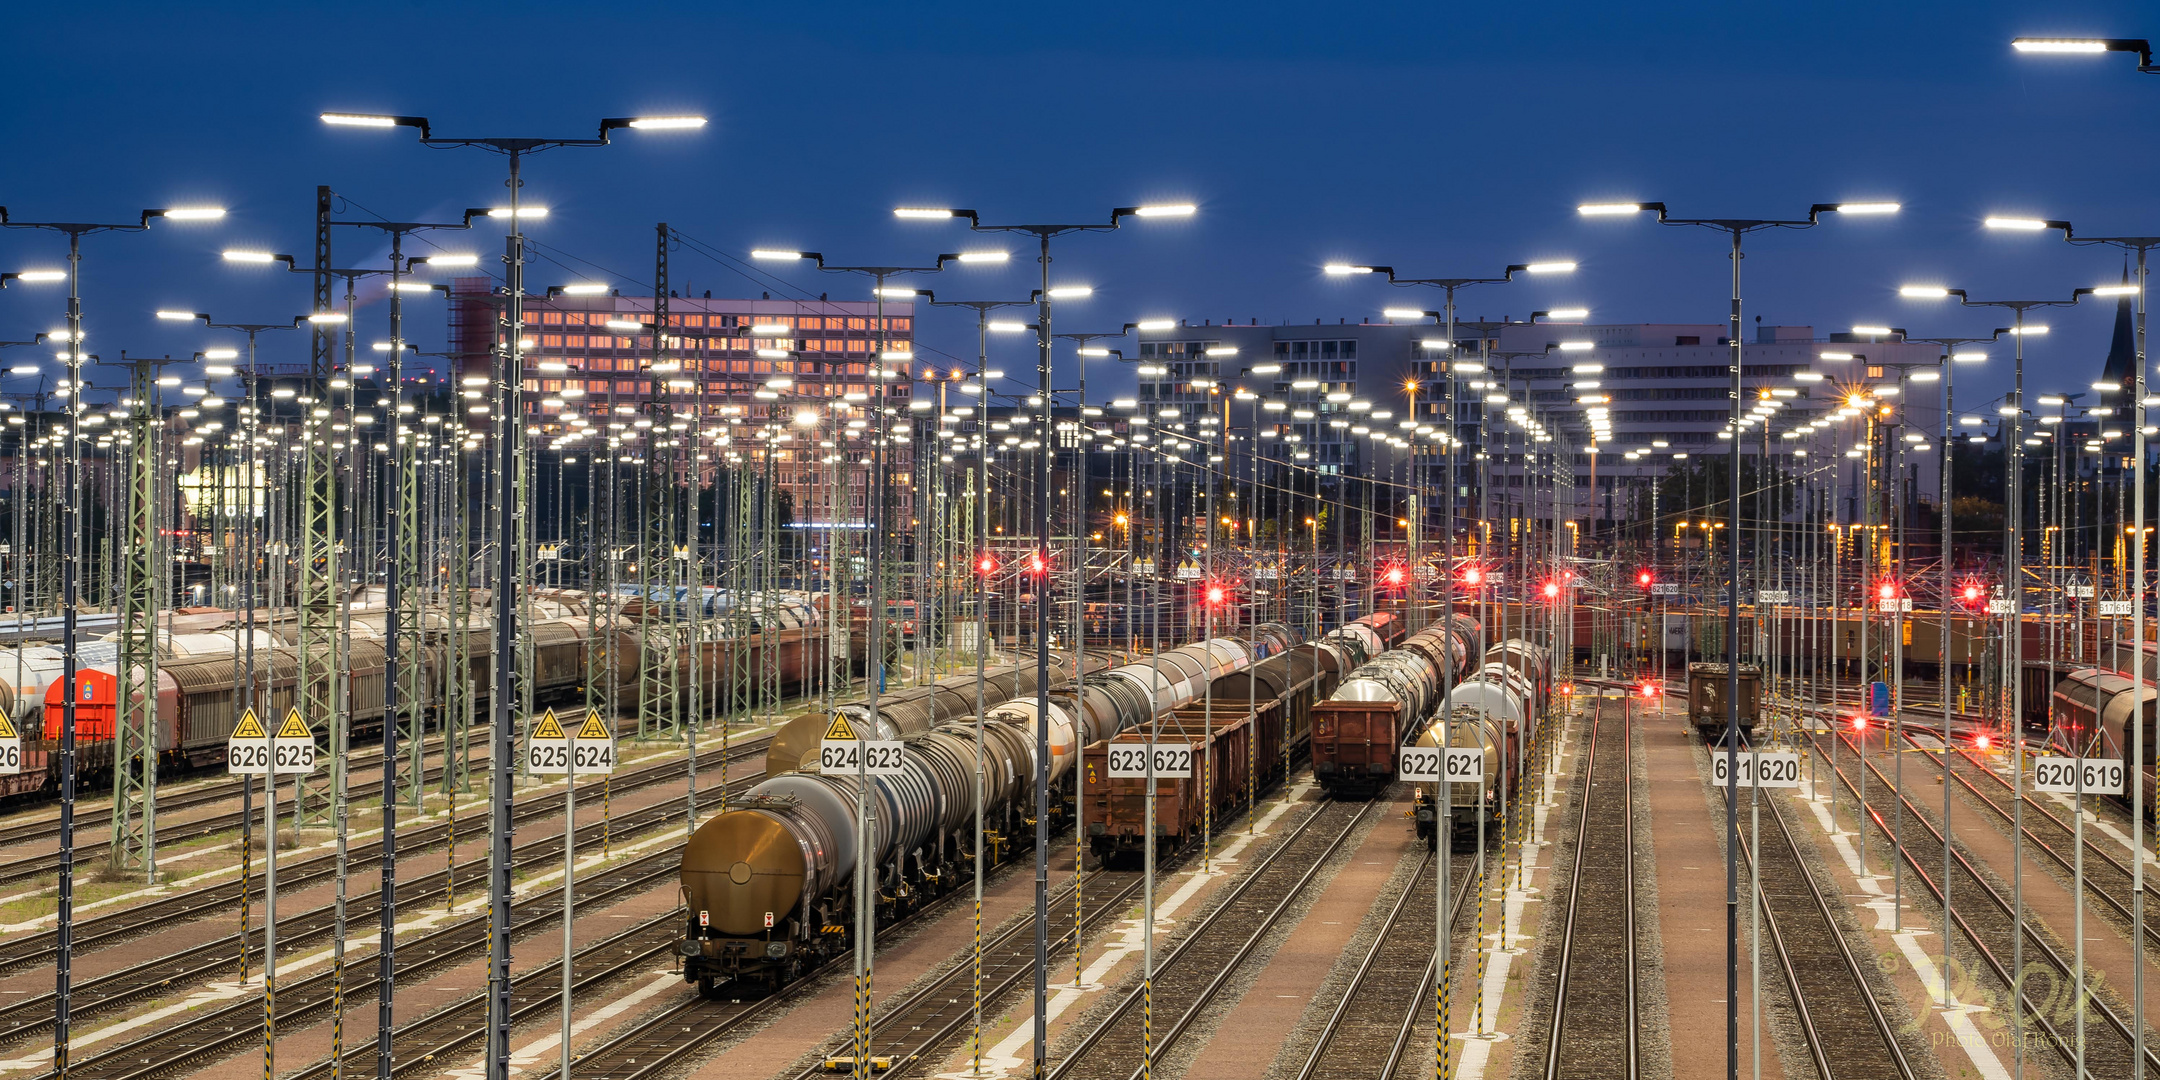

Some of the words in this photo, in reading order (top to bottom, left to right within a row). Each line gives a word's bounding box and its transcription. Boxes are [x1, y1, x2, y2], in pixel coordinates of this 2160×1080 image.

[1572, 578, 1583, 586] 621
[1652, 584, 1664, 593] 621
[1665, 584, 1678, 593] 620
[1880, 601, 1895, 610] 619
[1990, 602, 2005, 611] 618
[2100, 603, 2114, 612] 617
[2116, 603, 2130, 612] 616
[229, 745, 268, 767] 626
[275, 745, 314, 767] 625
[529, 746, 568, 768] 625
[574, 746, 612, 768] 624
[821, 747, 859, 769] 624
[865, 747, 903, 769] 623
[1109, 750, 1146, 772] 623
[1153, 750, 1190, 772] 622
[1401, 753, 1439, 775] 622
[1446, 754, 1482, 776] 621
[1759, 759, 1797, 782] 620
[2036, 763, 2076, 786] 620
[2083, 765, 2122, 788] 619
